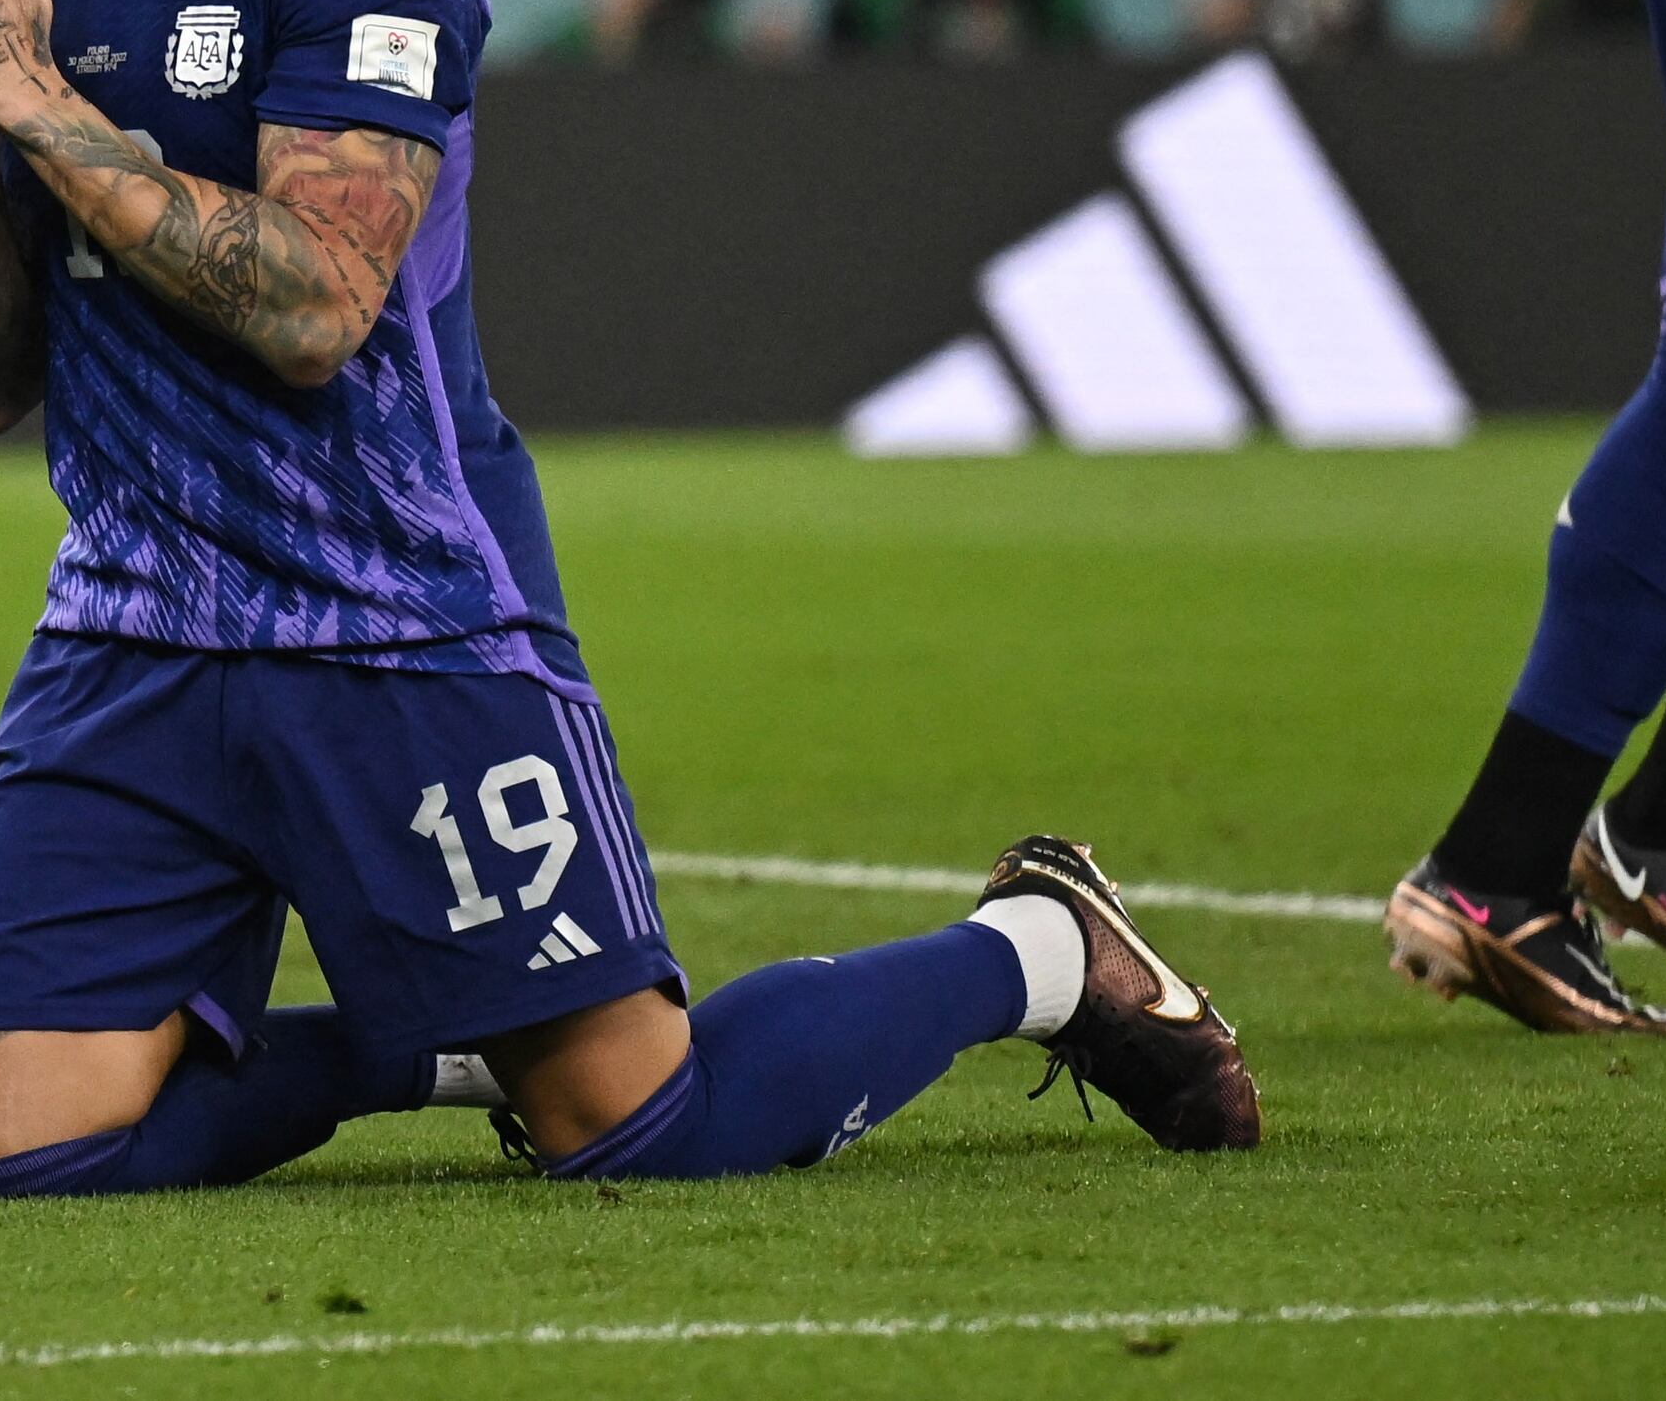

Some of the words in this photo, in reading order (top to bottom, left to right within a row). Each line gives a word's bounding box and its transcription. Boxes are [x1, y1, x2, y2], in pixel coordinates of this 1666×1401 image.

[87, 45, 110, 55] POLAND
[181, 30, 222, 71] AFA
[68, 57, 77, 66] 30
[379, 69, 411, 84] UNITES
[410, 754, 578, 932] 19
